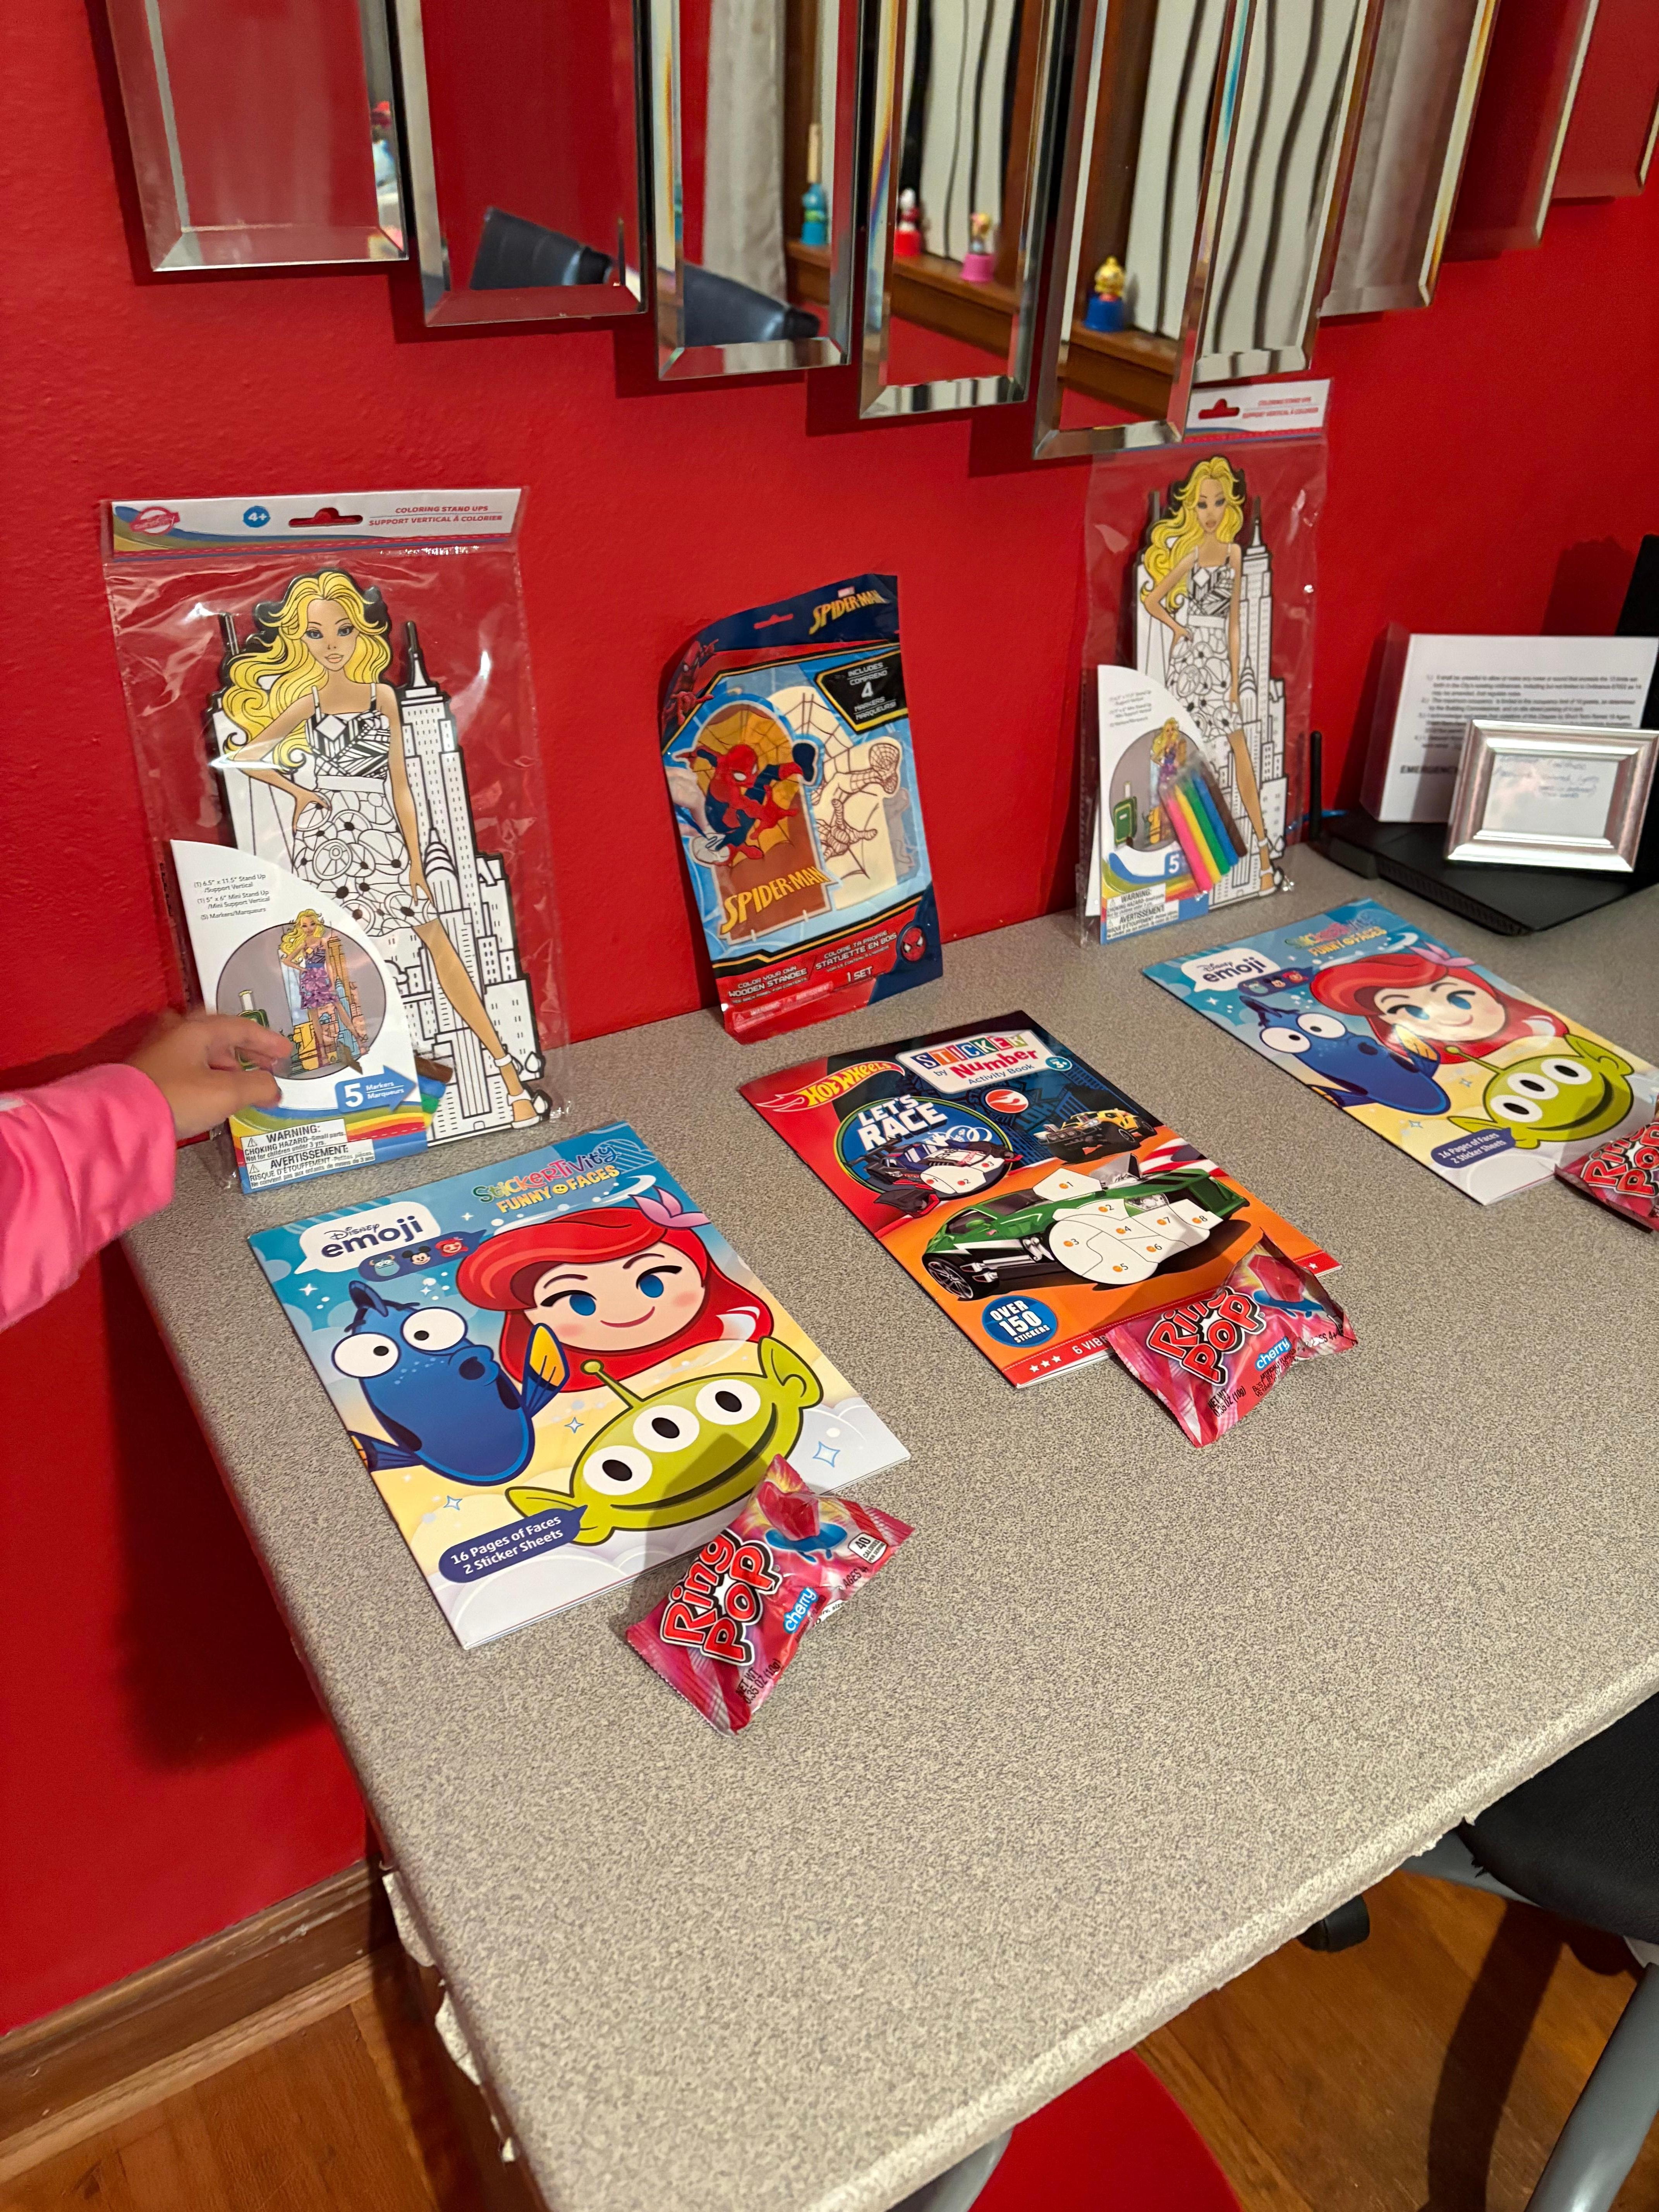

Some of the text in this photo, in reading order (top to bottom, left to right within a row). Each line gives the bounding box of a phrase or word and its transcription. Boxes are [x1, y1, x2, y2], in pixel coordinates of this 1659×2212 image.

[248, 512, 267, 522] 4+
[369, 518, 409, 526] SUPPORT
[847, 662, 884, 677] INCLUDES
[861, 681, 874, 698] 4
[854, 696, 886, 712] MARKERS
[1168, 853, 1180, 874] 5
[721, 866, 831, 934] SPIDER-MAN
[816, 946, 866, 970] STATUETTE
[868, 941, 879, 949] EN
[881, 932, 897, 945] BOIS
[1308, 939, 1346, 957] FUNNY
[738, 965, 797, 989] COLOR YOUR OWN
[854, 966, 873, 980] SET
[1202, 957, 1267, 982] emoji
[728, 968, 807, 997] WOODEN STANDEE
[913, 1036, 1027, 1069] STICKER
[949, 1049, 1039, 1079] Number
[968, 1063, 1035, 1085] Activity Book
[345, 1082, 364, 1107] 5
[366, 1082, 394, 1091] Markers
[367, 1089, 405, 1099] Marqueurs
[857, 1094, 919, 1127] LET'S
[266, 1124, 321, 1143] WARNING:
[857, 1102, 948, 1151] RACE
[244, 1143, 278, 1156] CHOKING
[267, 1148, 291, 1158] children
[292, 1144, 308, 1152] under
[1448, 1143, 1473, 1154] Pages
[1470, 1137, 1481, 1146] of
[1478, 1133, 1500, 1143] Faces
[1456, 1148, 1483, 1161] Sticker
[1480, 1140, 1507, 1152] Sheets
[270, 1144, 349, 1169] AVERTISSEMENT:
[1582, 1126, 1646, 1186] Rin
[249, 1170, 275, 1182] RISQUE
[496, 1165, 620, 1213] FUNNY FACES
[321, 1215, 424, 1258] emoji
[989, 1300, 1029, 1321] OVER
[999, 1310, 1042, 1337] 150
[1013, 1324, 1051, 1343] STICKERS
[1072, 1335, 1109, 1355] 6 VIBR
[1256, 1338, 1291, 1369] cherry
[1207, 1388, 1230, 1410] NET WT
[1212, 1403, 1227, 1417] 0.35
[1225, 1395, 1233, 1408] OZ
[1232, 1385, 1247, 1403] (10g)
[450, 1516, 562, 1565] 16 Pages of Faces
[463, 1529, 564, 1575] 2 Sticker Sheets
[855, 1537, 871, 1549] 40
[662, 1532, 737, 1645] Ring
[842, 1568, 862, 1589] AGES
[785, 1587, 817, 1632] cherry
[735, 1667, 759, 1698] NET WT
[743, 1685, 759, 1704] 0.35
[754, 1675, 768, 1688] OZ
